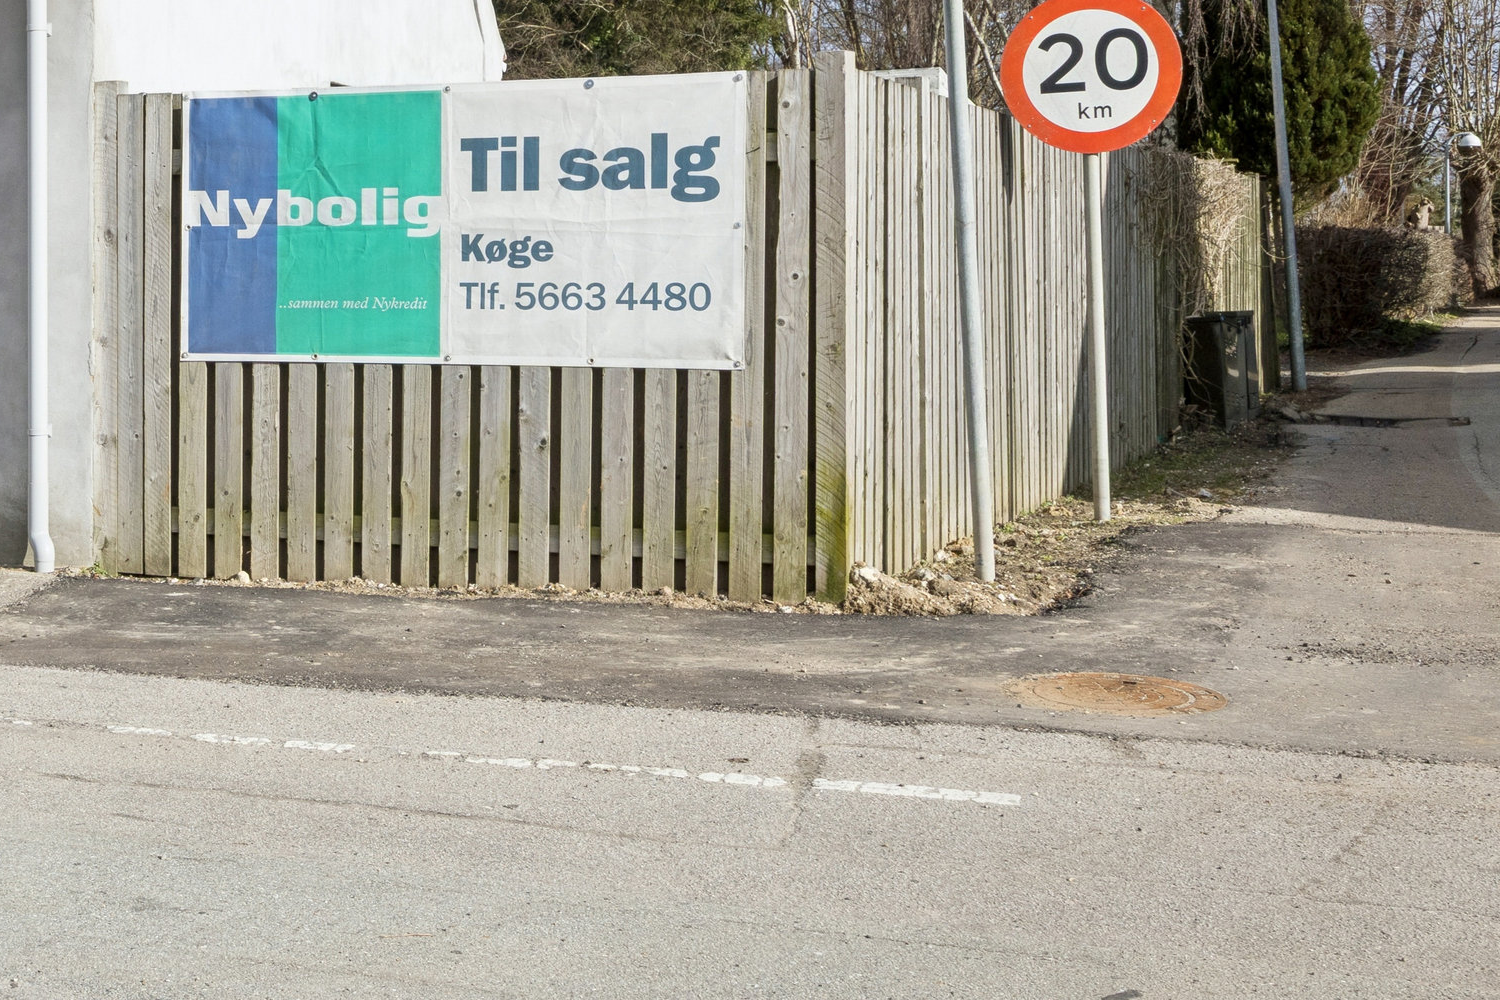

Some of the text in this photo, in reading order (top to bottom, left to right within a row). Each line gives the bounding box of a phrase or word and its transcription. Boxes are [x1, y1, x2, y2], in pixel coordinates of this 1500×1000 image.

[1037, 27, 1149, 95] 20
[1077, 103, 1113, 120] km
[460, 132, 721, 203] Til salg
[189, 187, 442, 239] Nybolig
[460, 233, 554, 269] Køge
[342, 297, 369, 309] med
[372, 296, 428, 312] Nykredit
[459, 281, 712, 311] Tlf. 5663 4480
